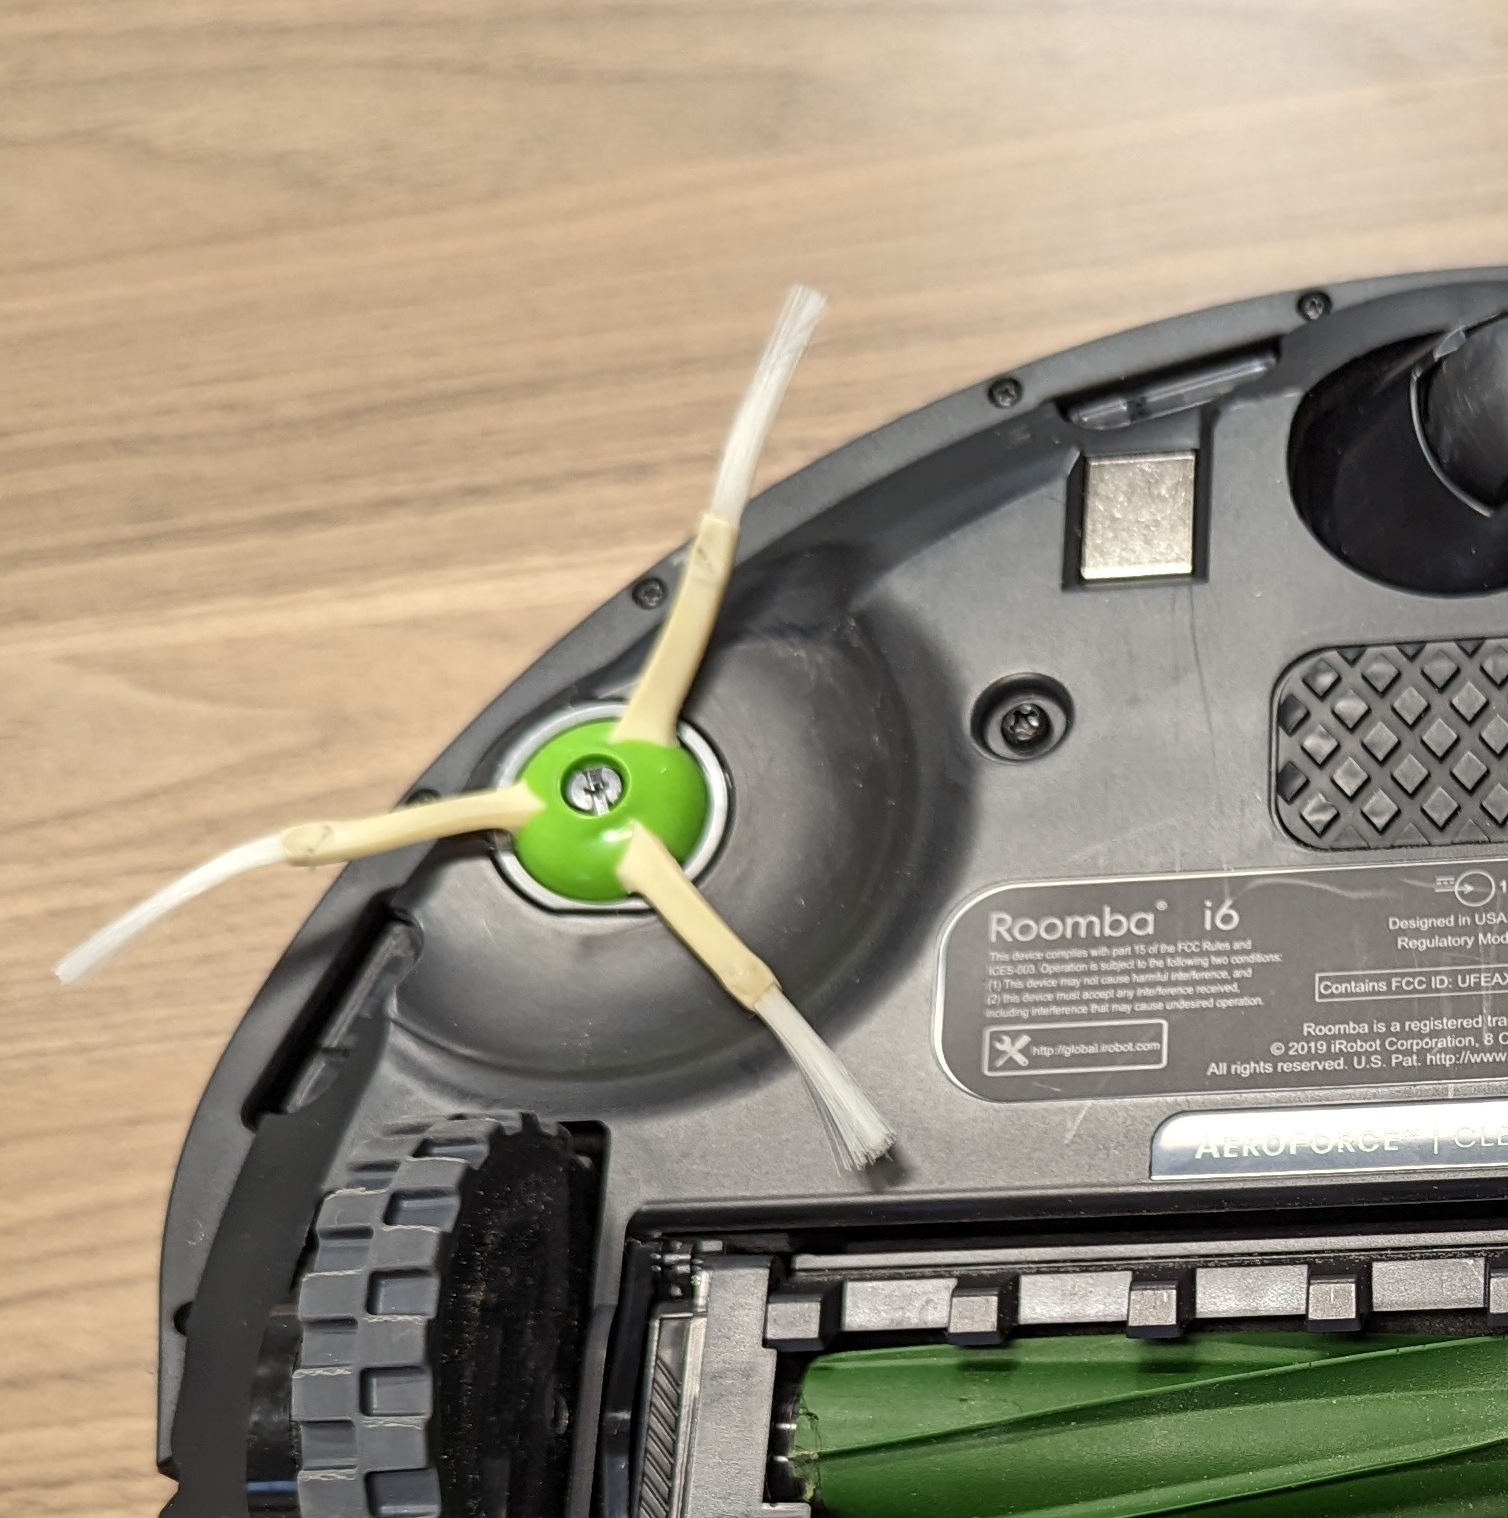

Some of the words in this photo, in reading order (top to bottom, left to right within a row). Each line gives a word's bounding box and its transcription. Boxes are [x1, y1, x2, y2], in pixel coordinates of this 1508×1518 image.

[1203, 899, 1240, 931] i6
[1388, 914, 1455, 931] Designed
[1458, 914, 1471, 926] in
[1397, 935, 1475, 952] Regulatory
[1319, 979, 1387, 995] Contains
[1391, 976, 1426, 991] FCC
[1431, 975, 1453, 989] ID:
[1303, 1020, 1369, 1037] Roomba
[1373, 1019, 1386, 1033] is
[1390, 1021, 1400, 1032] a
[1404, 1014, 1483, 1034] registered
[1288, 1041, 1327, 1056] 2019
[1330, 1039, 1381, 1053] iRobot
[1385, 1035, 1479, 1052] Corporation,
[1484, 1032, 1494, 1046] 8
[1206, 1061, 1227, 1076] All
[1230, 1060, 1273, 1077] rights
[1277, 1057, 1348, 1073] reserved.
[1353, 1054, 1387, 1069] U.S.
[1391, 1053, 1421, 1068] Pat.
